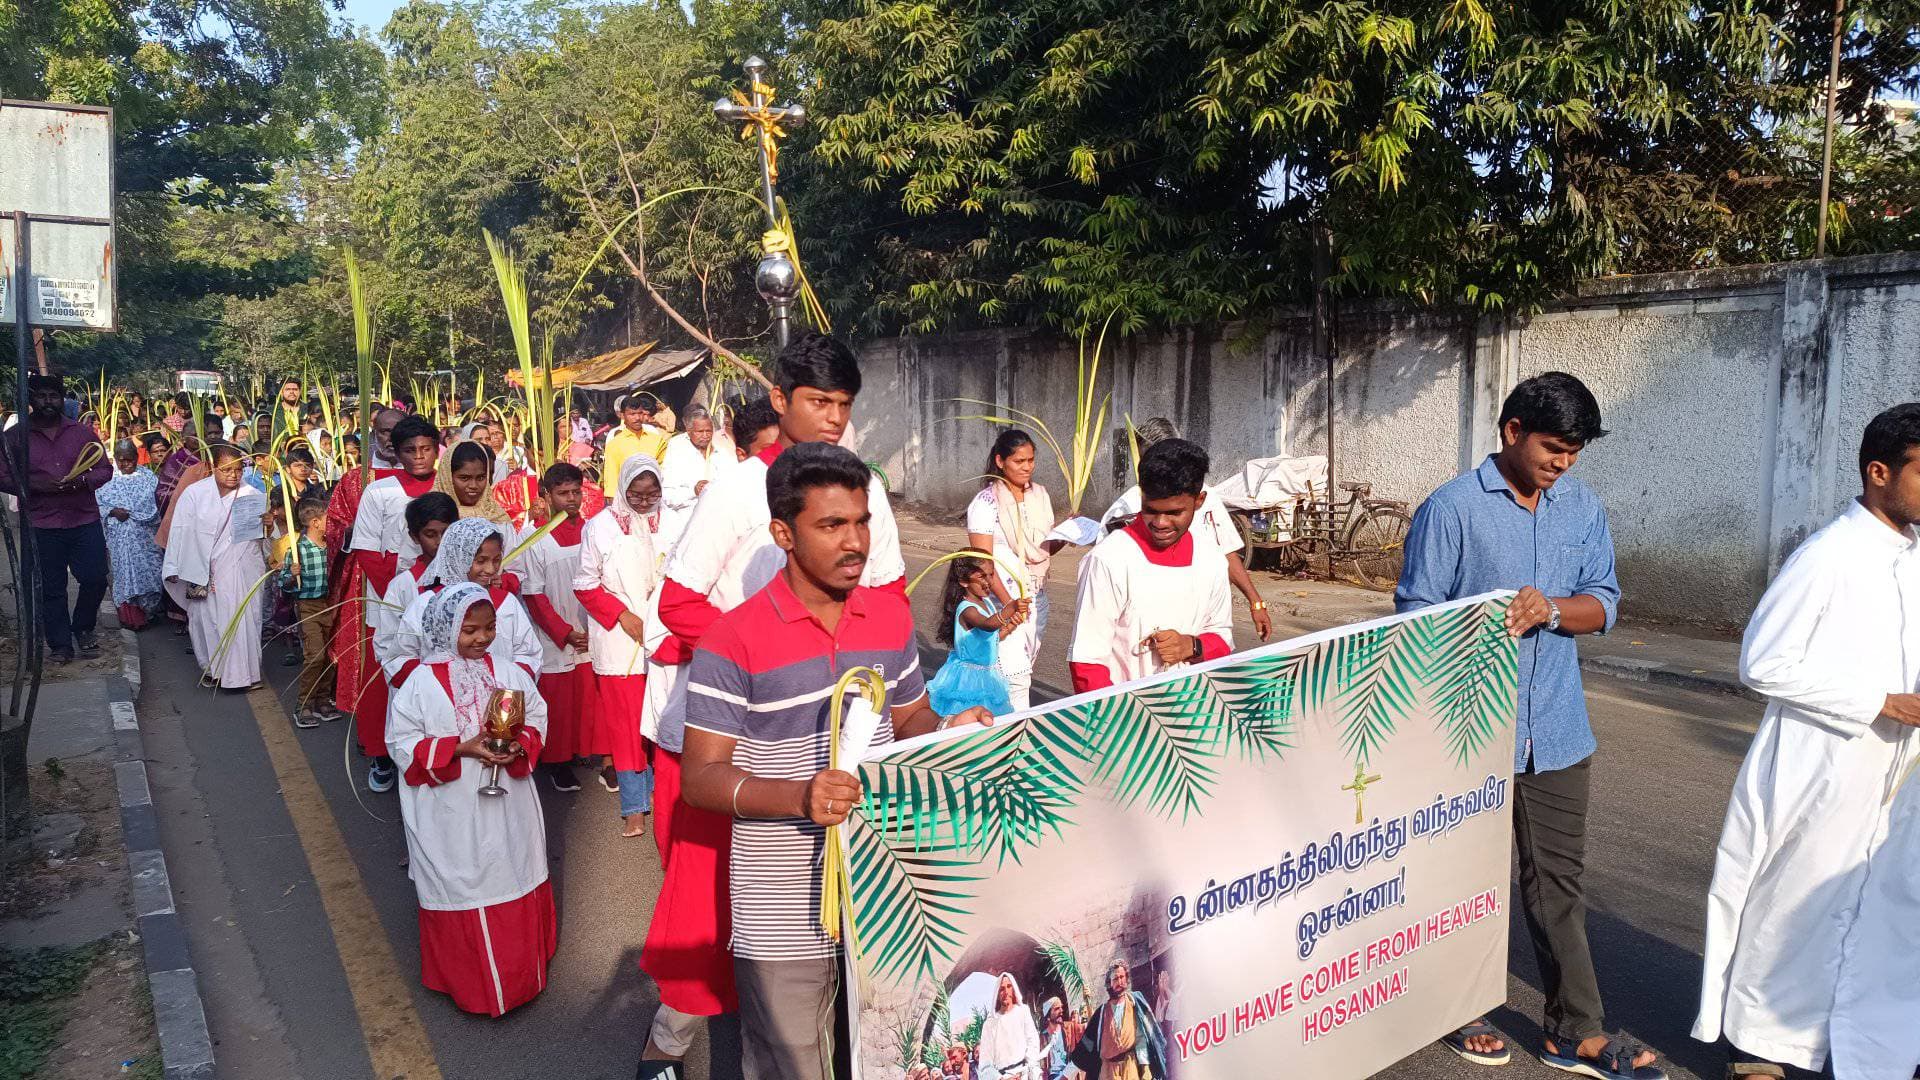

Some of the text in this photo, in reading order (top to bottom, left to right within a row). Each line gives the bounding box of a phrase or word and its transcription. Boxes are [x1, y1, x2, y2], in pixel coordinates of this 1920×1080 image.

[1168, 774, 1507, 934] உன்னதத்திலிருந்து வந்தவரே
[1298, 867, 1407, 958] ஓசன்னா!
[1176, 889, 1502, 1059] YOU HAVE COME FROM HEAVEN,
[1303, 968, 1409, 1042] HOSANNA!
